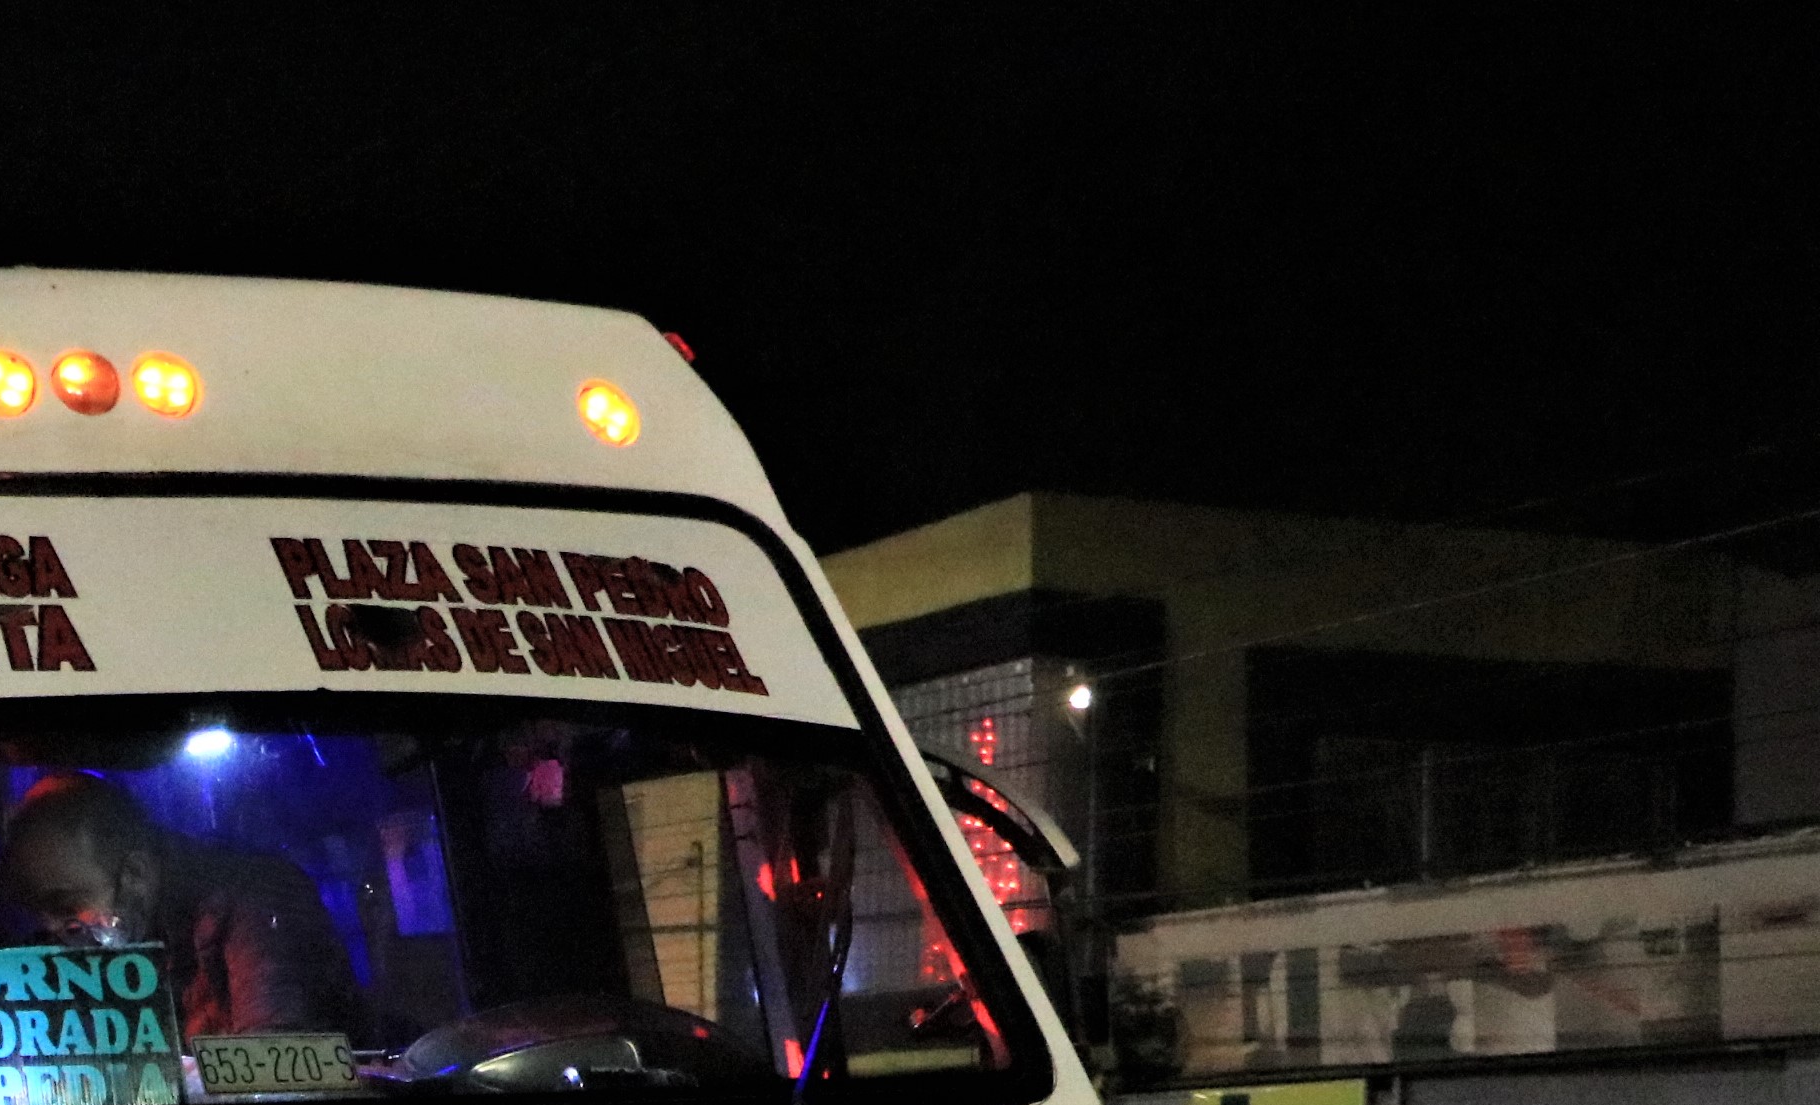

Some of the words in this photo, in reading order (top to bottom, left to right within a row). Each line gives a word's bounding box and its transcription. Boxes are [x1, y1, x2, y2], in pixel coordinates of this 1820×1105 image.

[270, 537, 464, 603] PLAZA
[452, 543, 573, 610] SAN
[449, 607, 532, 675] DE
[516, 610, 621, 680] SAN
[601, 617, 770, 697] MIGUEL
[197, 1045, 356, 1086] 653-220-S
